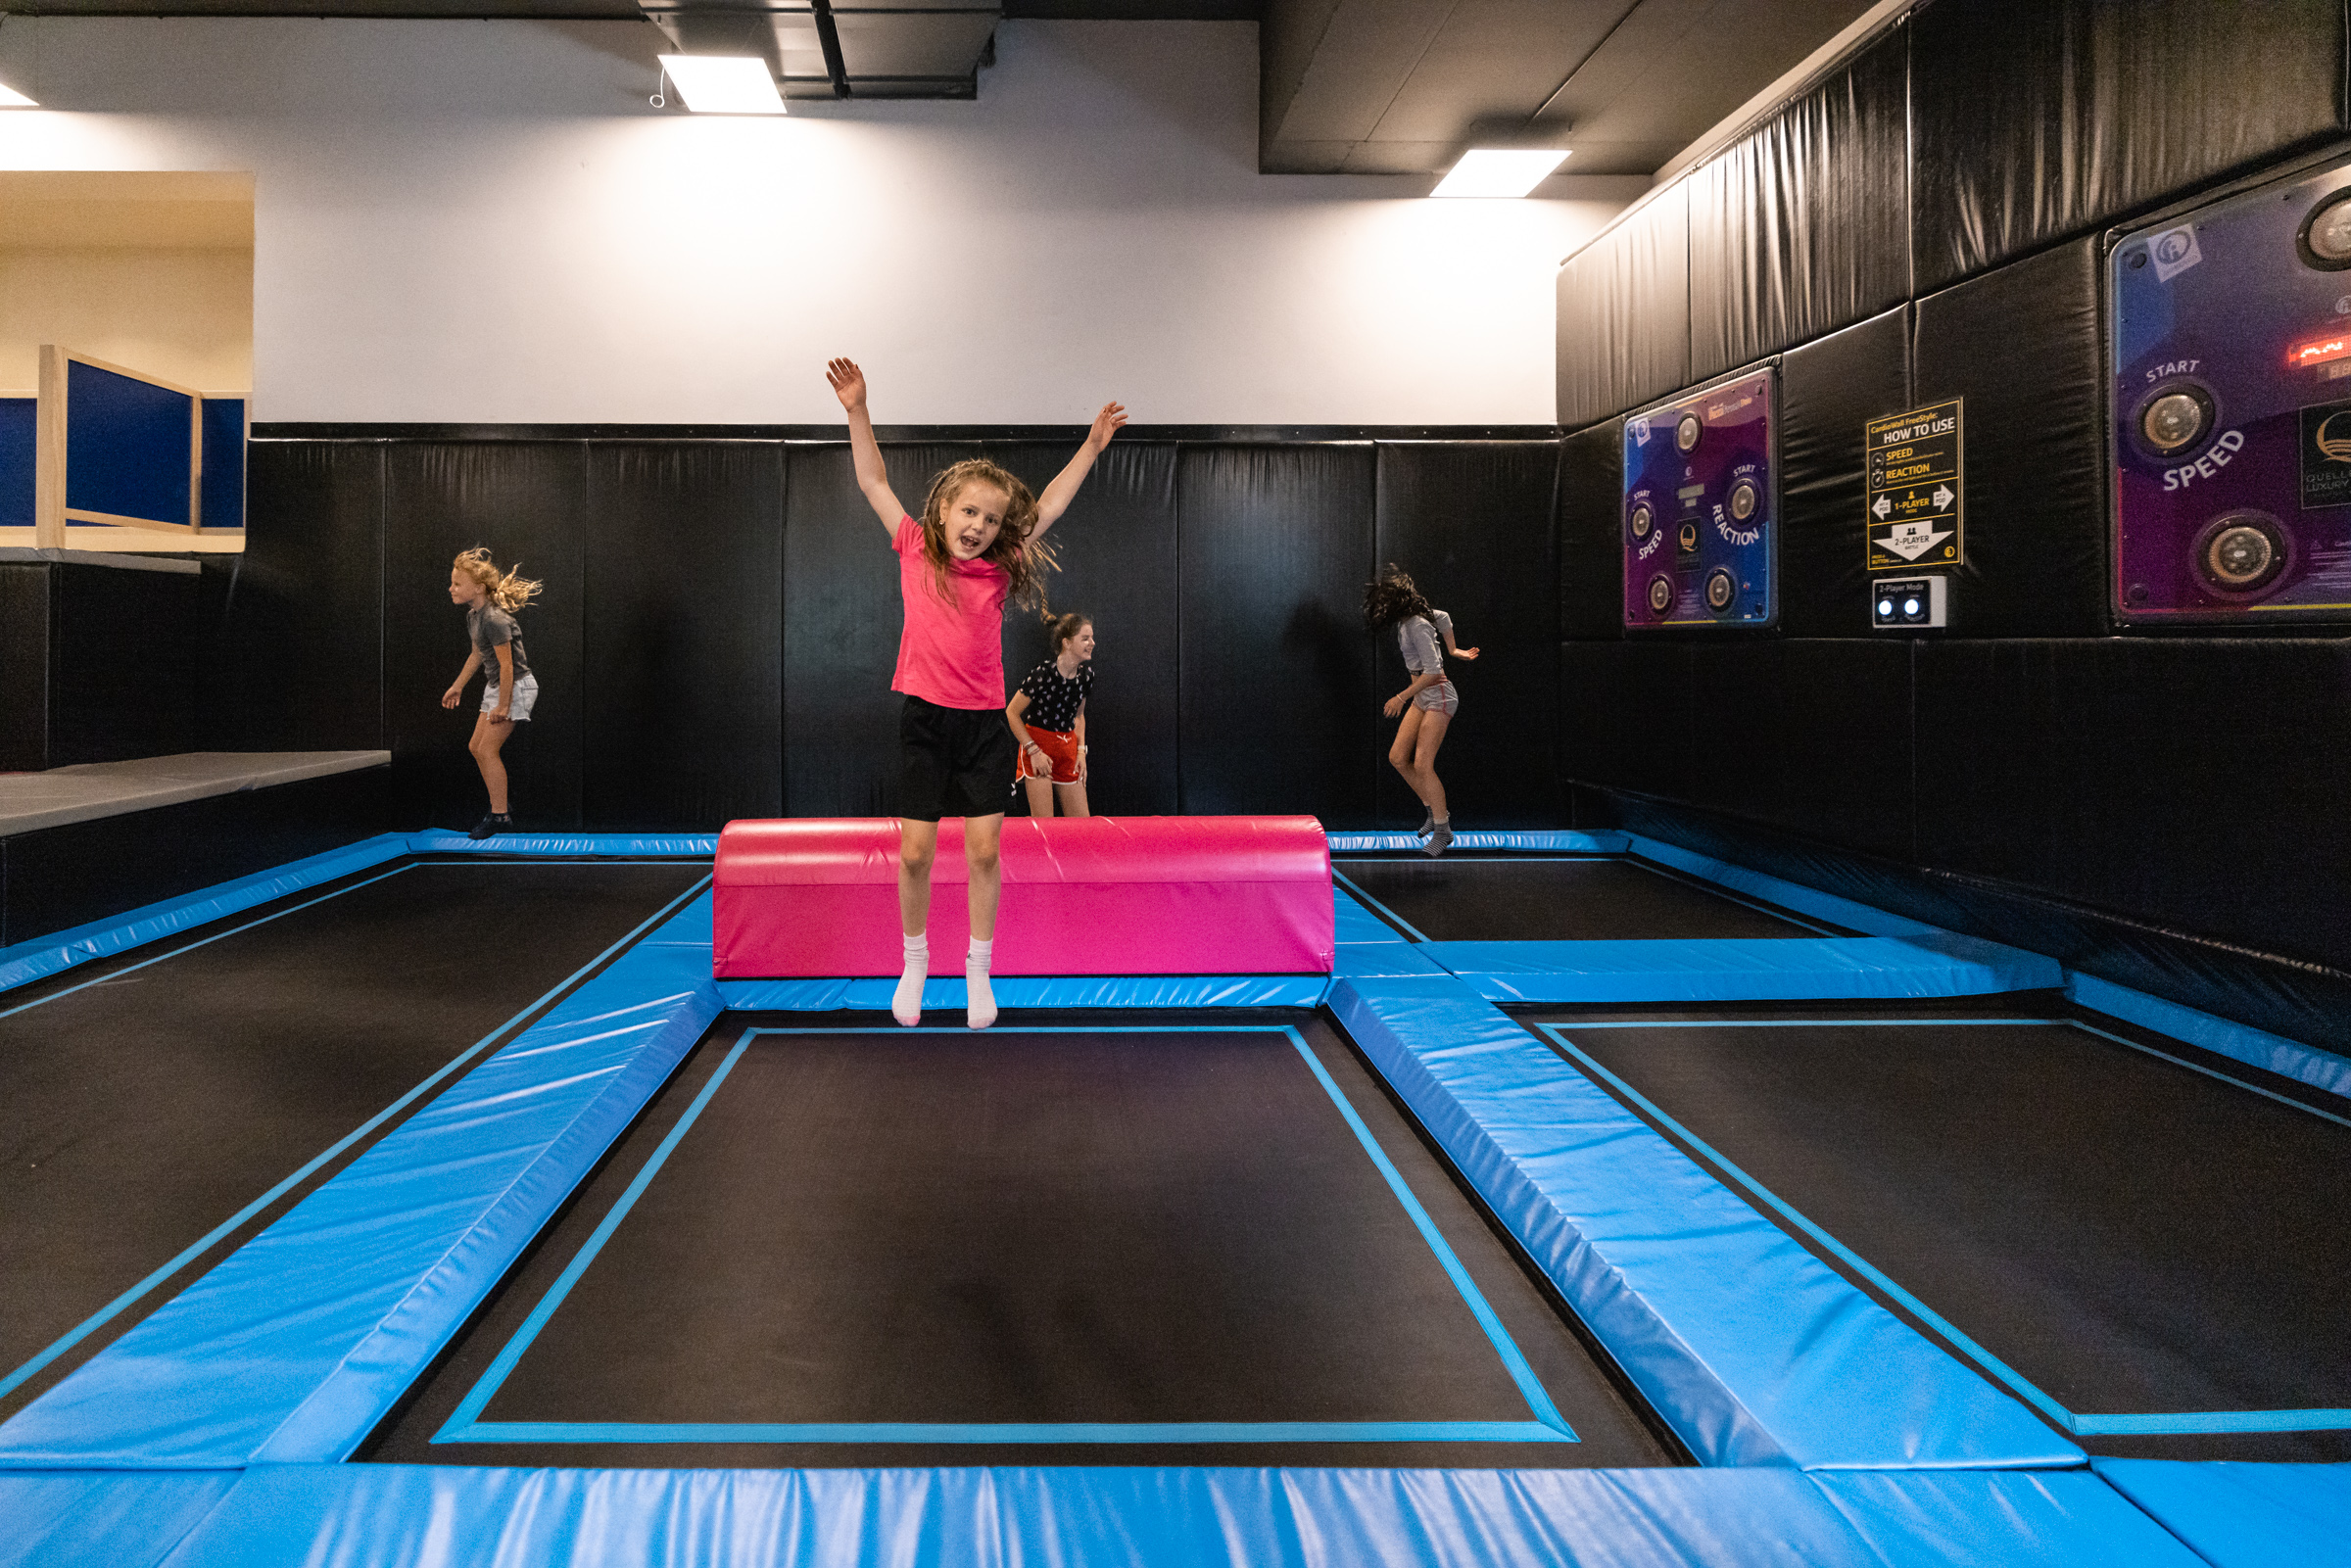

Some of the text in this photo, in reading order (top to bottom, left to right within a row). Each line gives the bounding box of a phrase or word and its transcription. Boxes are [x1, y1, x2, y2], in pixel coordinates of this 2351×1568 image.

[2146, 359, 2200, 383] START
[1871, 420, 1905, 434] CardioWall
[1884, 417, 1955, 444] HOW TO USE
[1886, 448, 1913, 461] SPEED
[2163, 430, 2244, 491] SPEED
[1733, 464, 1755, 478] START
[1886, 463, 1930, 479] REACTION
[2306, 479, 2349, 493] LUXURY
[1633, 490, 1651, 500] START
[1895, 498, 1930, 510] 1-PLAYER
[1712, 504, 1759, 546] REACTION
[1638, 530, 1662, 560] SPEED
[1895, 535, 1930, 546] 2-PLAYER
[1880, 584, 1905, 593] 2-Player
